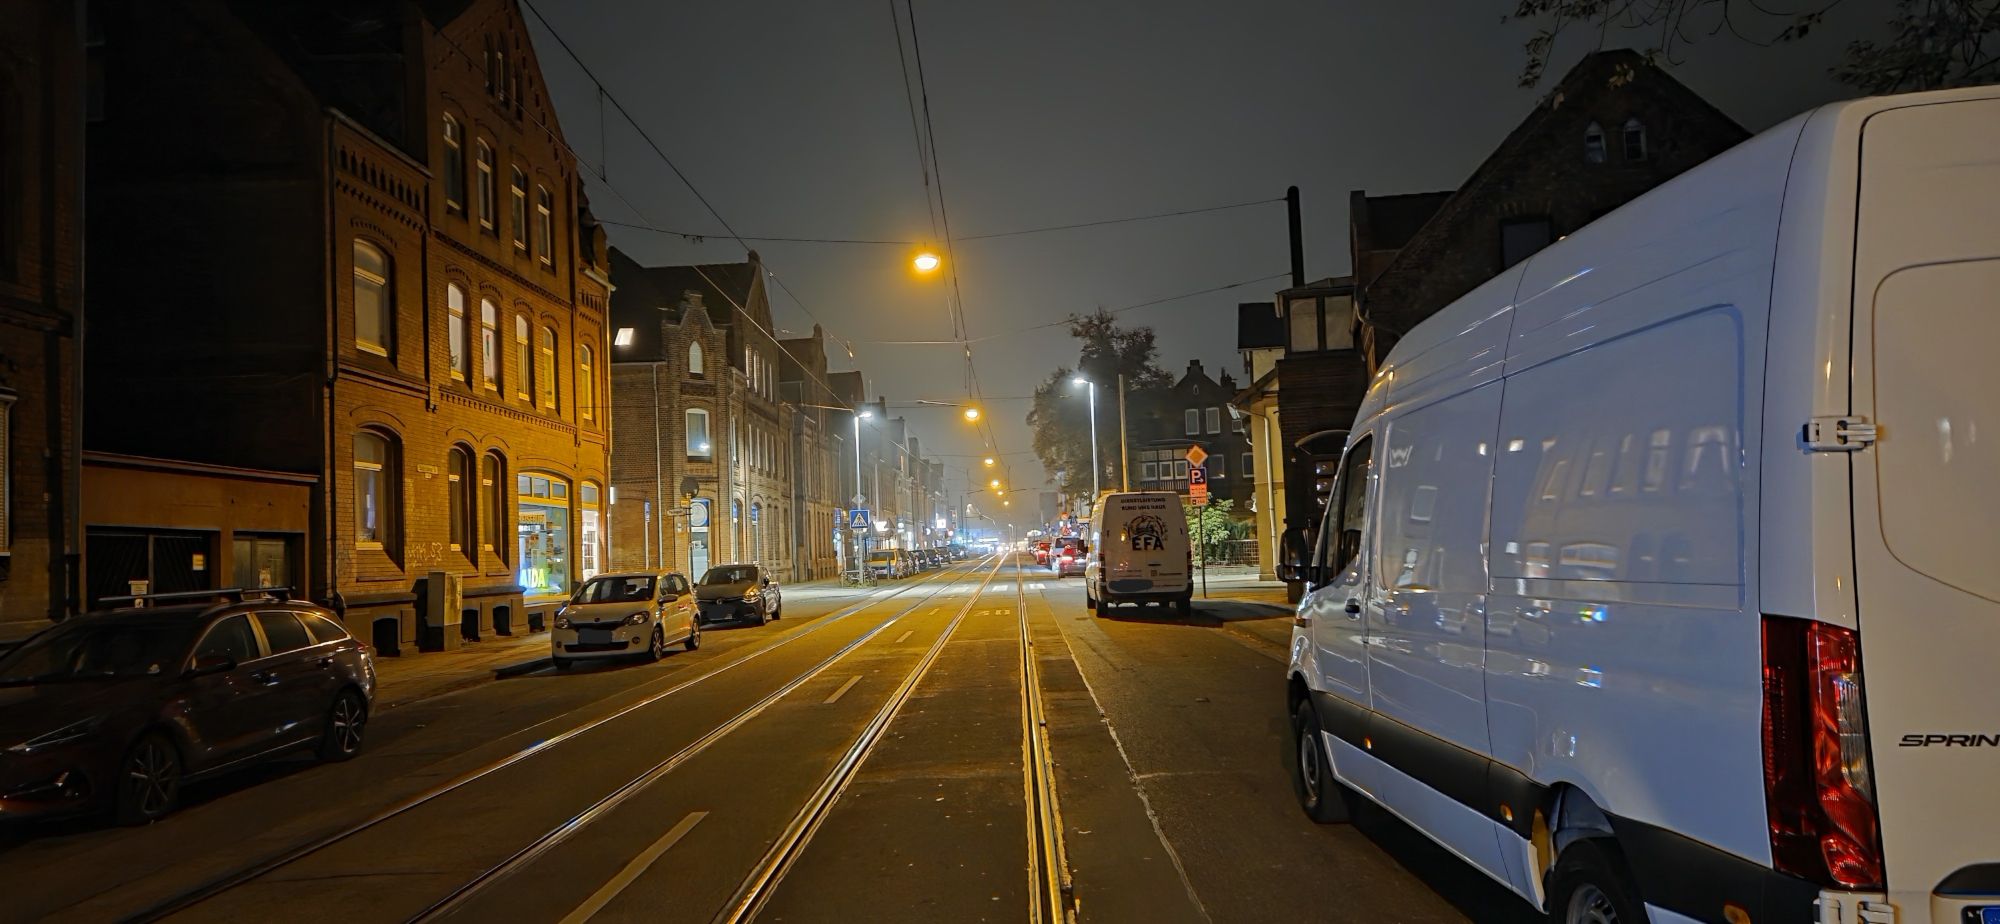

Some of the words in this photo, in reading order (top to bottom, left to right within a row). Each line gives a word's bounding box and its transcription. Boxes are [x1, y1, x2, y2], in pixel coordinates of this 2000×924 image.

[1191, 470, 1201, 483] P
[1132, 536, 1165, 551] EFA
[518, 567, 545, 588] AIDA
[1898, 734, 2000, 747] SPRIN
